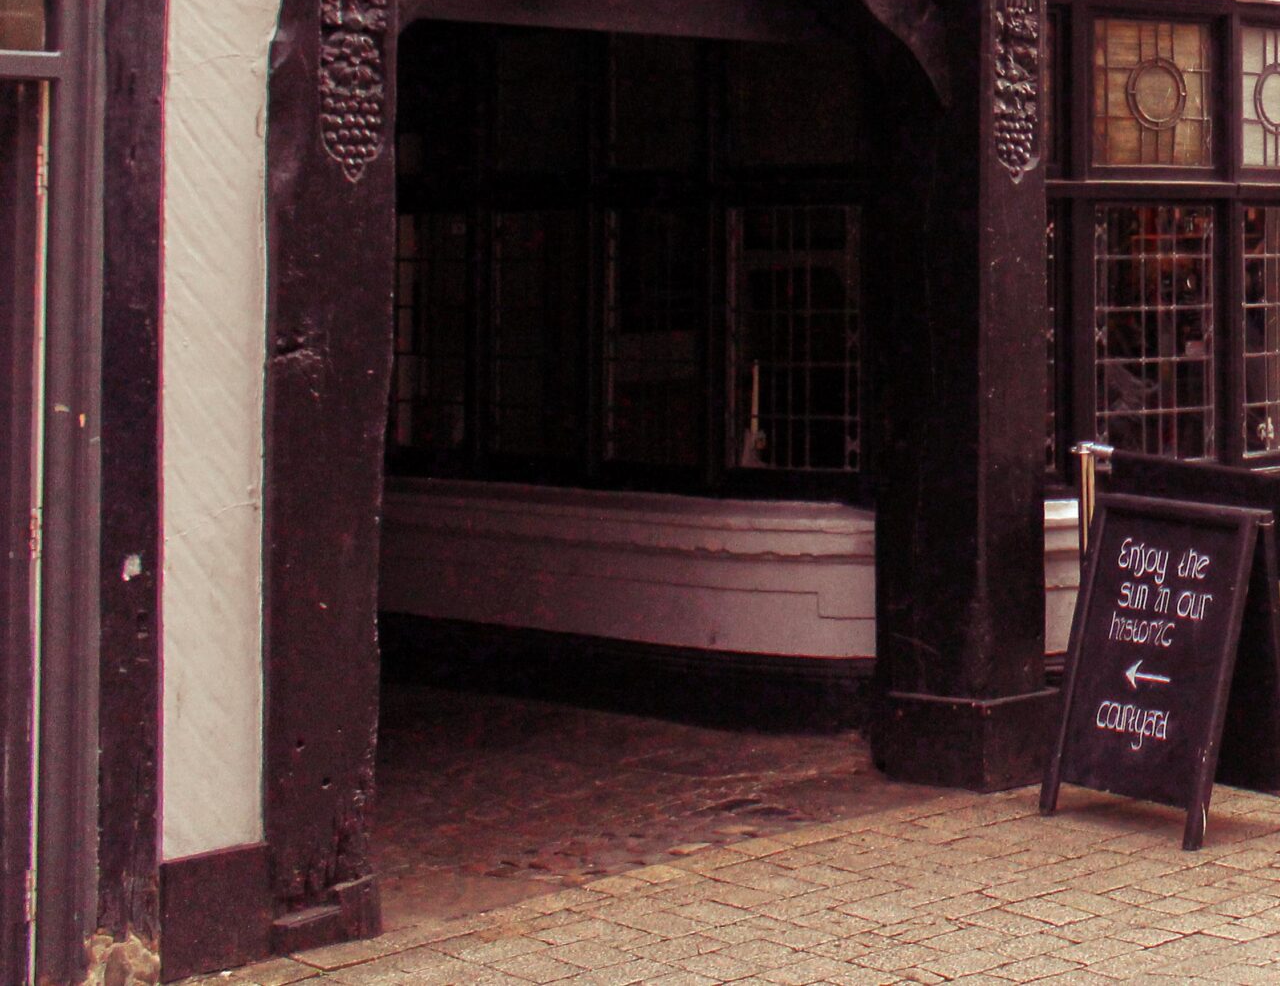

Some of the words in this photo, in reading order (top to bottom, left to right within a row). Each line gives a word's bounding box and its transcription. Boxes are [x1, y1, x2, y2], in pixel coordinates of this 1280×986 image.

[1117, 537, 1169, 584] Enjoy
[1177, 548, 1211, 579] the
[1117, 581, 1149, 610] sun
[1154, 584, 1171, 614] in
[1176, 591, 1213, 621] our
[1108, 610, 1176, 647] historic
[1095, 699, 1170, 751] courtyard
